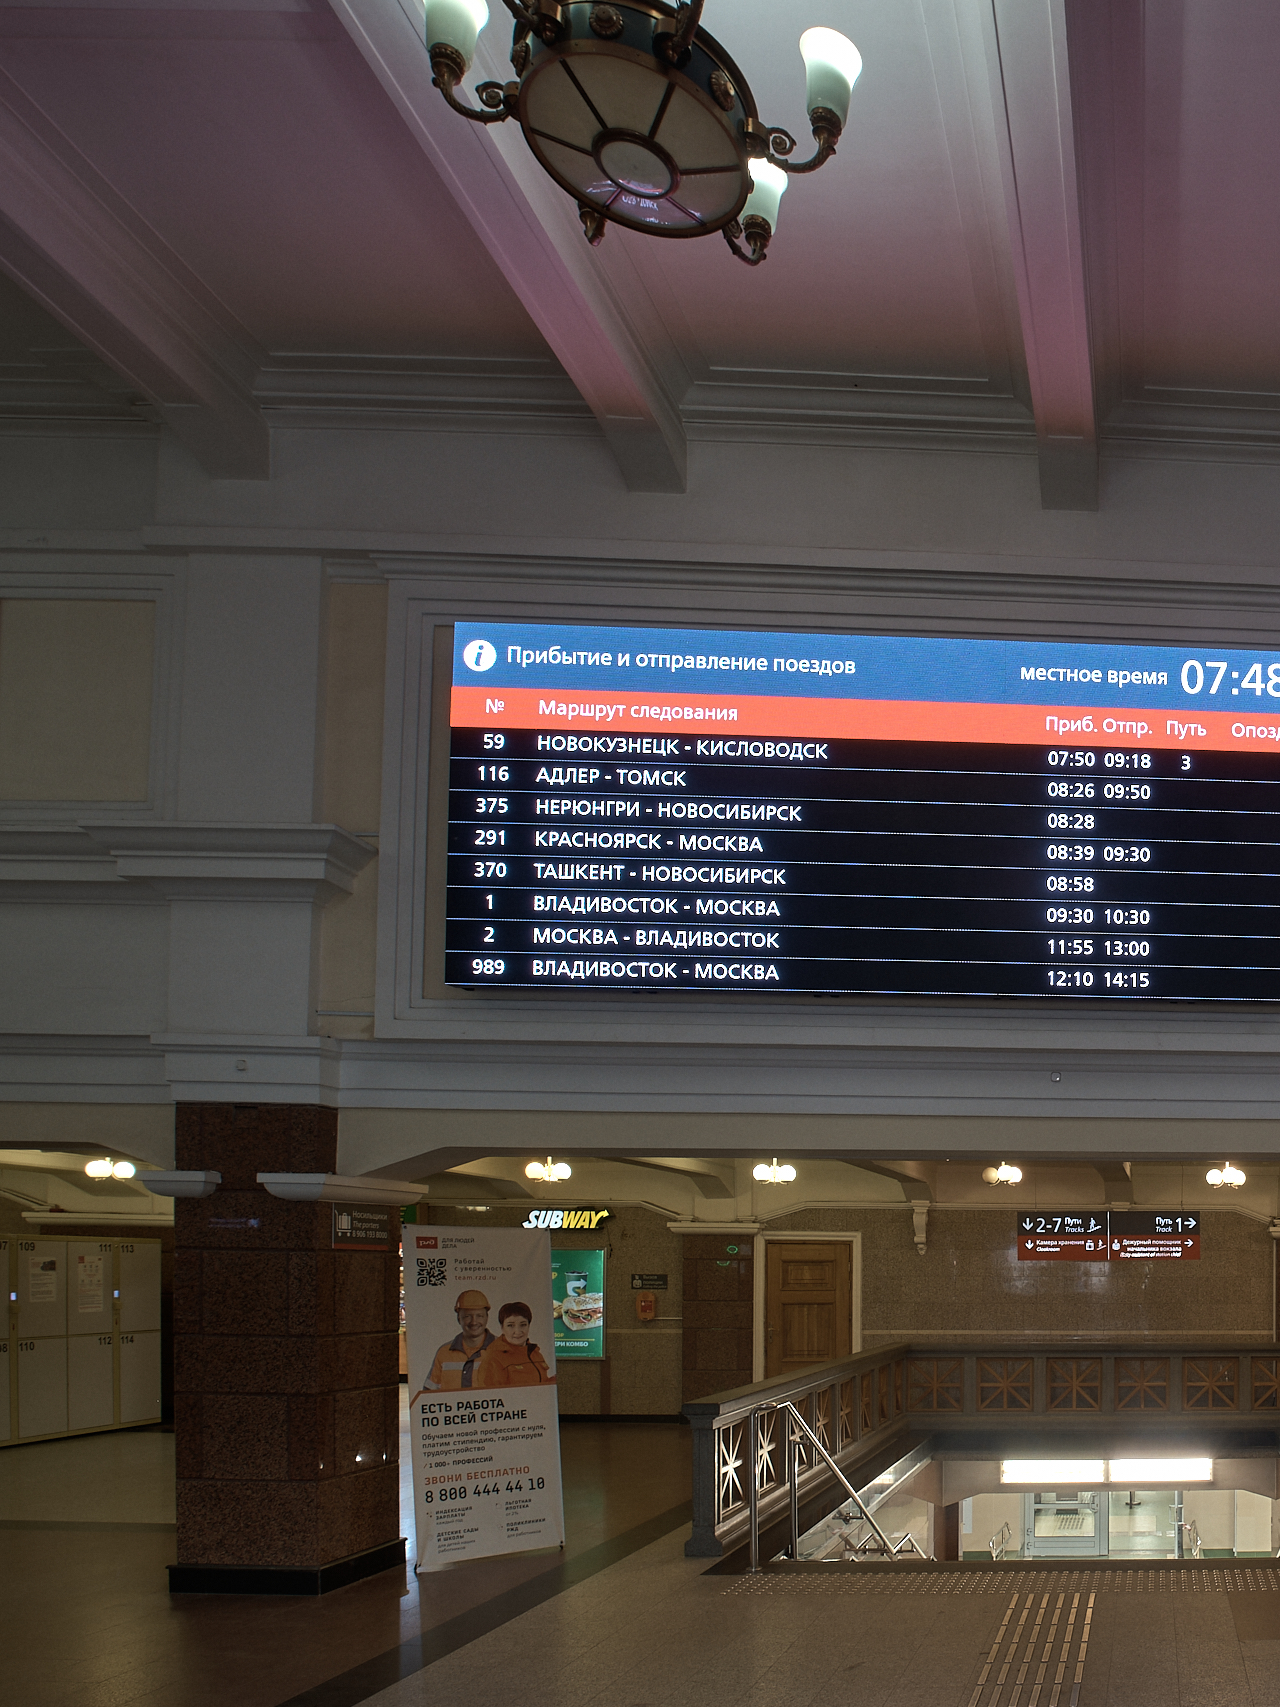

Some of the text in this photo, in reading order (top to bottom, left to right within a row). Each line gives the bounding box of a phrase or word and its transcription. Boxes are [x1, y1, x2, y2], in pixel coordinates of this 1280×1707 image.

[507, 645, 856, 677] Прибытие и отправление поездов
[1020, 666, 1103, 683] местное
[1107, 669, 1168, 689] время
[485, 698, 505, 714] №
[538, 699, 627, 722] Маршрут
[630, 705, 738, 722] следования
[1045, 715, 1098, 736] Приб.
[1102, 718, 1153, 739] Отпр.
[1166, 719, 1207, 740] Путь
[483, 733, 1192, 771] 59 НОВОКУЗНЕЦК КИСЛОВОДСК 07:50 09:18 3
[477, 765, 1151, 800] 116 АДЛЕР ТОМСК 08:26 09:50
[475, 797, 1095, 830] 375 НЕРЮНГРИ НОВОСИБИРСК 08:28
[474, 829, 1151, 863] 291 КРАСНОЯРСК МОСКВА 08:39 09:30
[473, 861, 1095, 893] 370 ТАШКЕНТ НОВОСИБИРСК 08:58
[485, 894, 1151, 925] 1 ВЛАДИВОСТОК МОСКВА 09:30 10:30
[483, 926, 1150, 957] 2 МОСКВА ВЛАДИВОСТОК 11:55 13:00
[471, 958, 1150, 988] 989 ВЛАДИВОСТОК МОСКВА 12:10 14:15
[352, 1210, 388, 1221] Носильщики
[522, 1209, 610, 1229] SUBWAY
[1064, 1217, 1082, 1226] Пути
[1155, 1216, 1182, 1233] Путь 1
[352, 1220, 380, 1230] The porters
[1036, 1217, 1062, 1233] 2-7
[19, 1241, 36, 1252] 109
[98, 1243, 112, 1253] 111
[120, 1244, 135, 1254] 113
[18, 1341, 35, 1352] 110
[98, 1336, 112, 1345] 112
[120, 1335, 134, 1344] 114
[421, 1398, 505, 1414] ЕСТЬ РАБОТА
[422, 1409, 528, 1427] ПО ВСЕЙ СТРАНЕ
[421, 1433, 454, 1442] Обучаем
[456, 1429, 478, 1438] новой
[480, 1426, 520, 1436] профессии
[527, 1424, 546, 1432] нуля,
[422, 1431, 544, 1449] платим стипендию, гарантируем
[423, 1445, 486, 1458] трудоустройство
[452, 1455, 494, 1466] ПРОФЕССИЙ
[424, 1465, 530, 1486] ЗВОНИ БЕСПЛАТНО
[425, 1476, 545, 1504] 8 800 444 44 10
